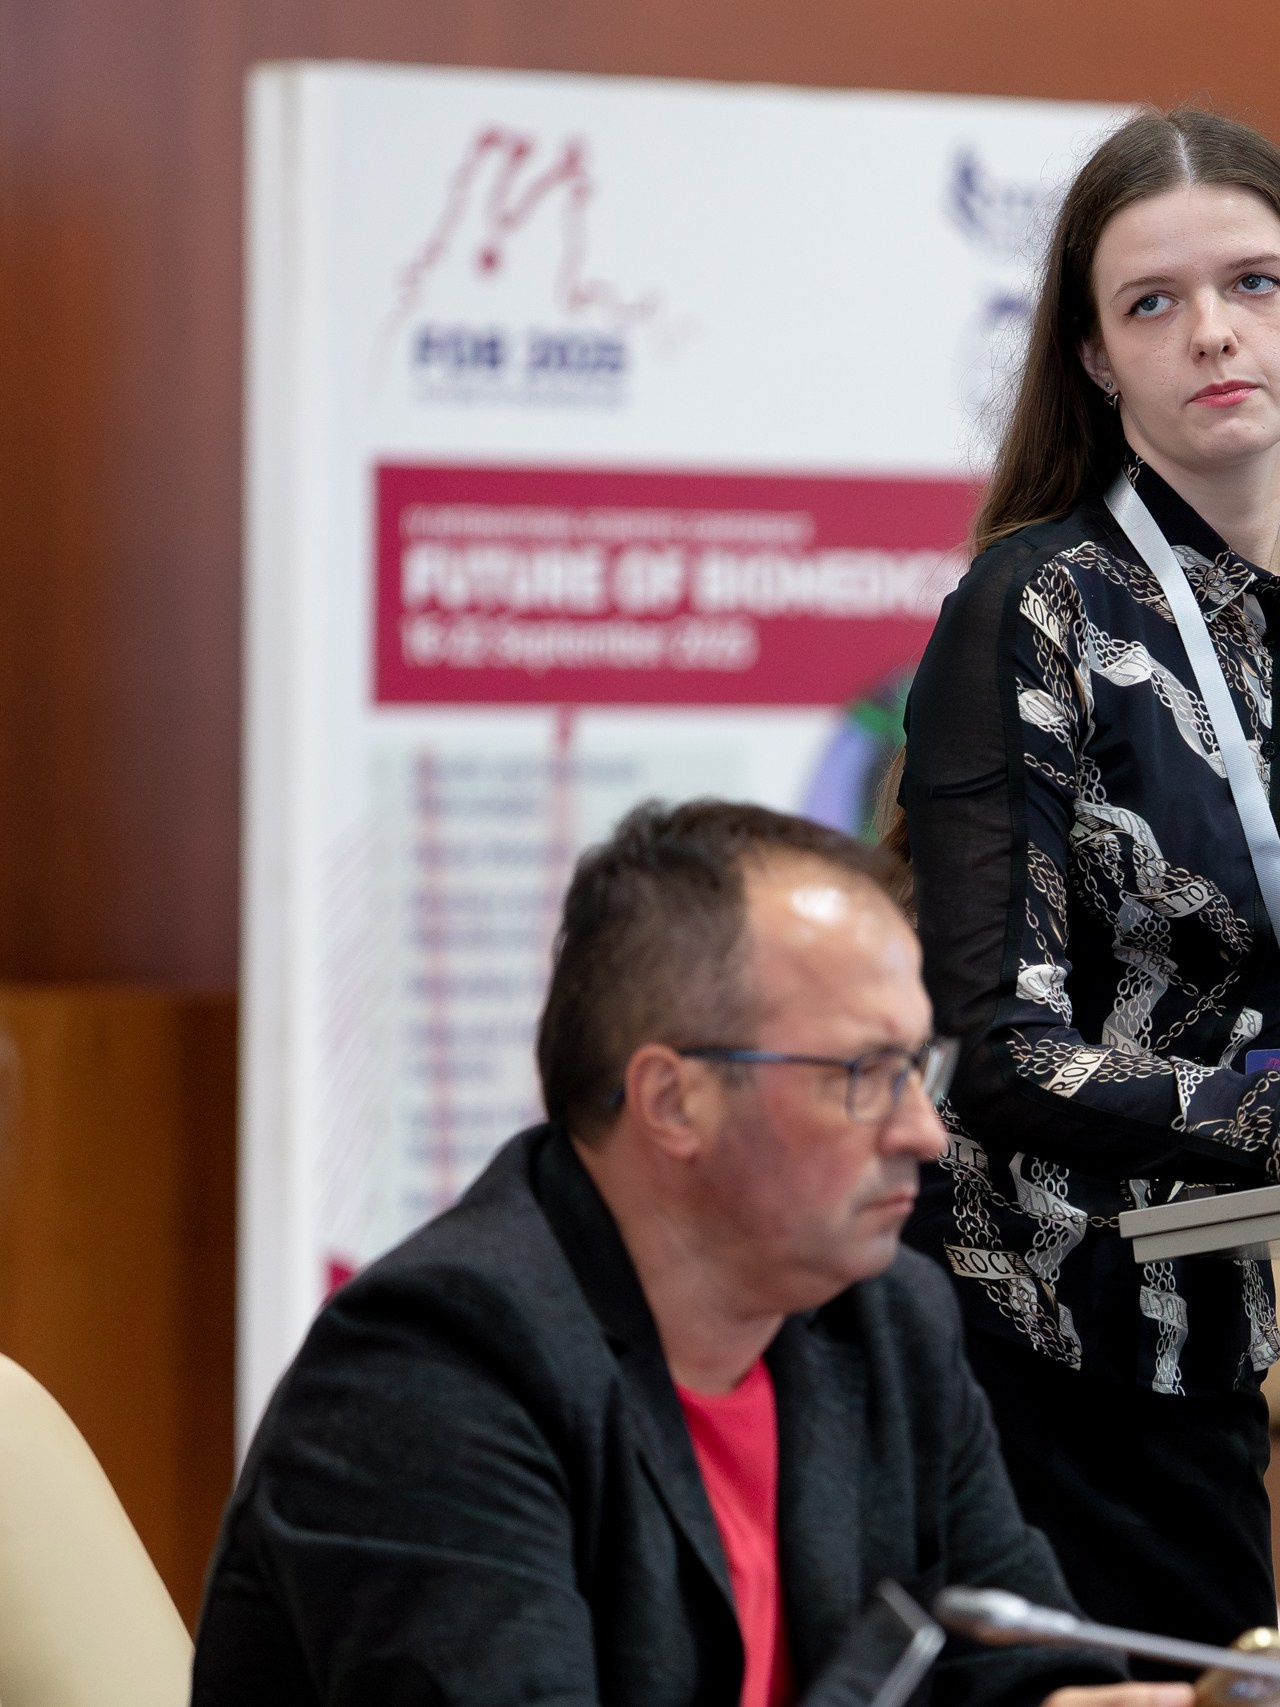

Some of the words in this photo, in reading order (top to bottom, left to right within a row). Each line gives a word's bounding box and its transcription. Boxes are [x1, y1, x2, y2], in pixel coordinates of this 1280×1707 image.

[405, 545, 603, 611] FUTURE
[612, 546, 684, 613] OF
[950, 1250, 1033, 1277] ROCK
